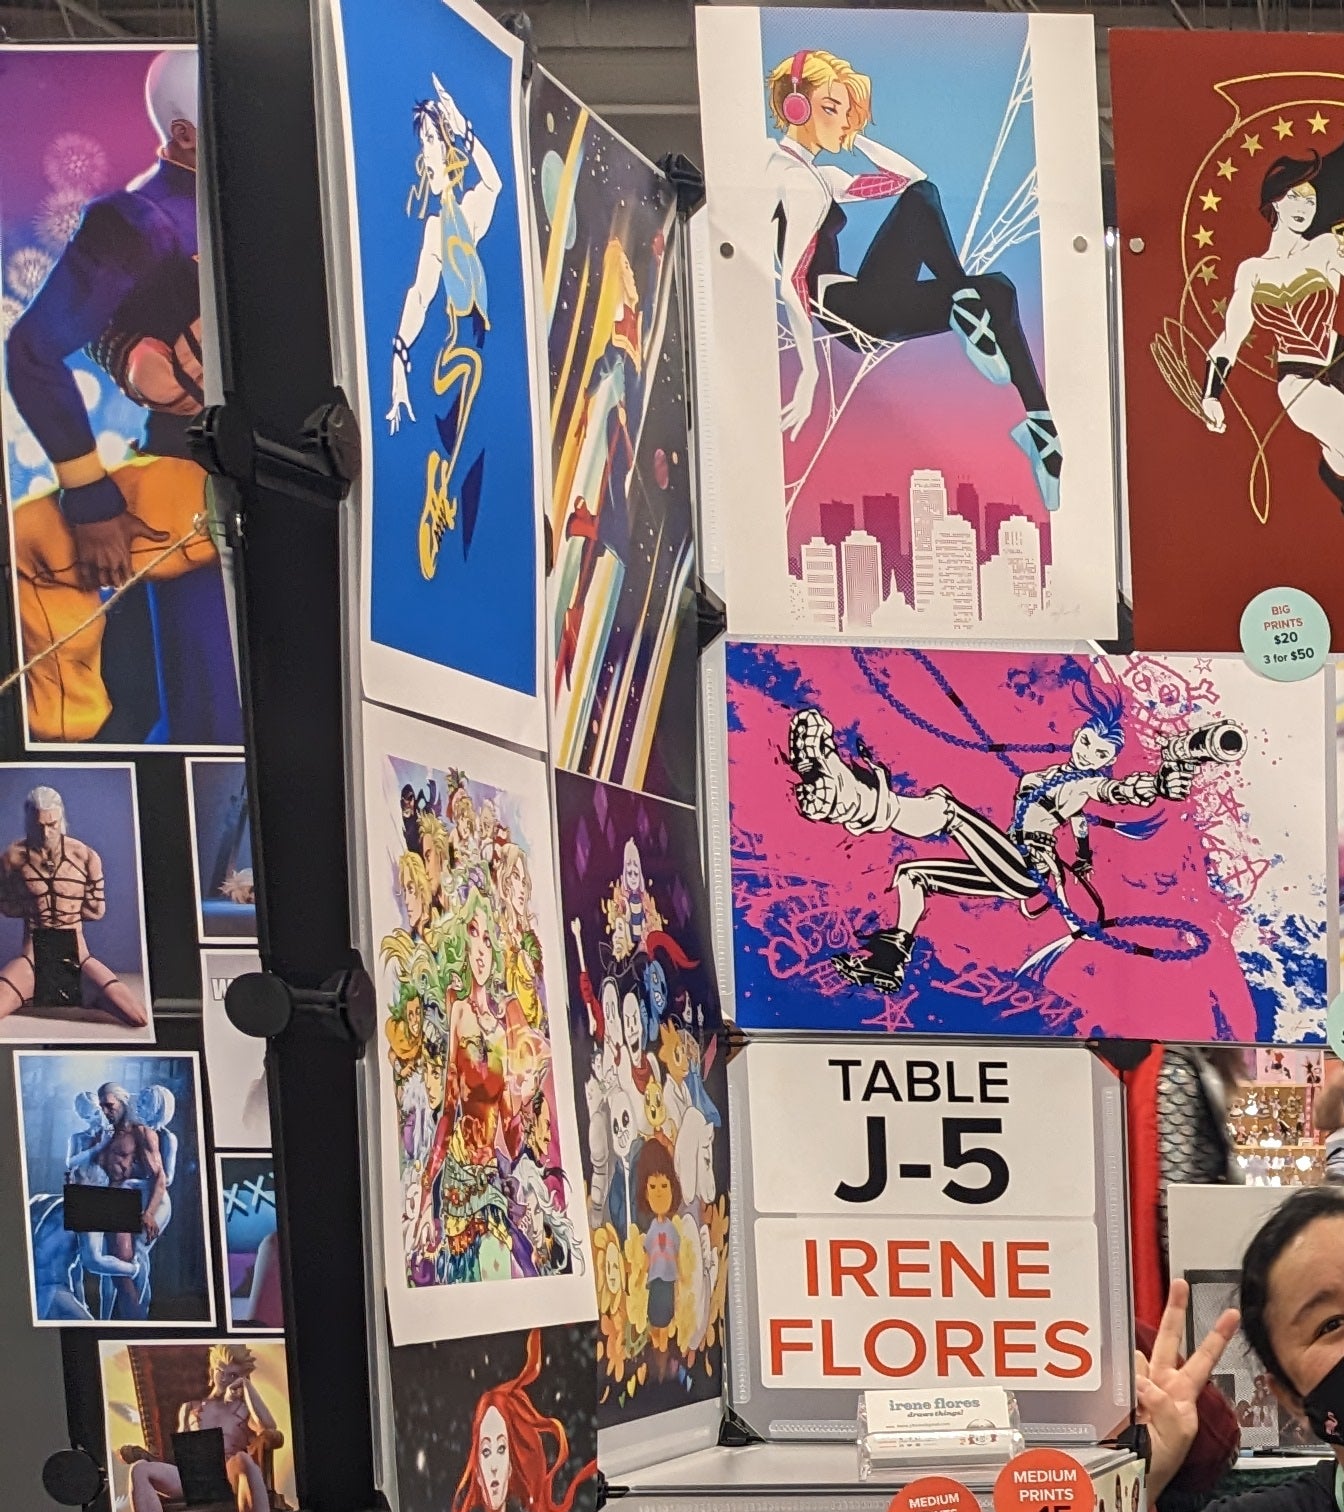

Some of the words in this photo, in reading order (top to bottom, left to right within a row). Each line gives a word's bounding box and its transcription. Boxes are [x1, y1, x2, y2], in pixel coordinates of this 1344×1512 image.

[1271, 605, 1290, 615] BIG
[1263, 618, 1303, 631] PRINTS
[1274, 632, 1298, 645] $20
[1273, 654, 1288, 663] for
[1290, 647, 1314, 661] $50
[828, 1059, 1010, 1104] TABLE
[834, 1116, 1010, 1204] J-5
[804, 1239, 1051, 1299] IRENE
[769, 1318, 1093, 1379] FLORES
[1013, 1469, 1077, 1483] MEDIUM
[909, 1493, 959, 1509] MEDIUM
[1019, 1488, 1074, 1502] PRINTS
